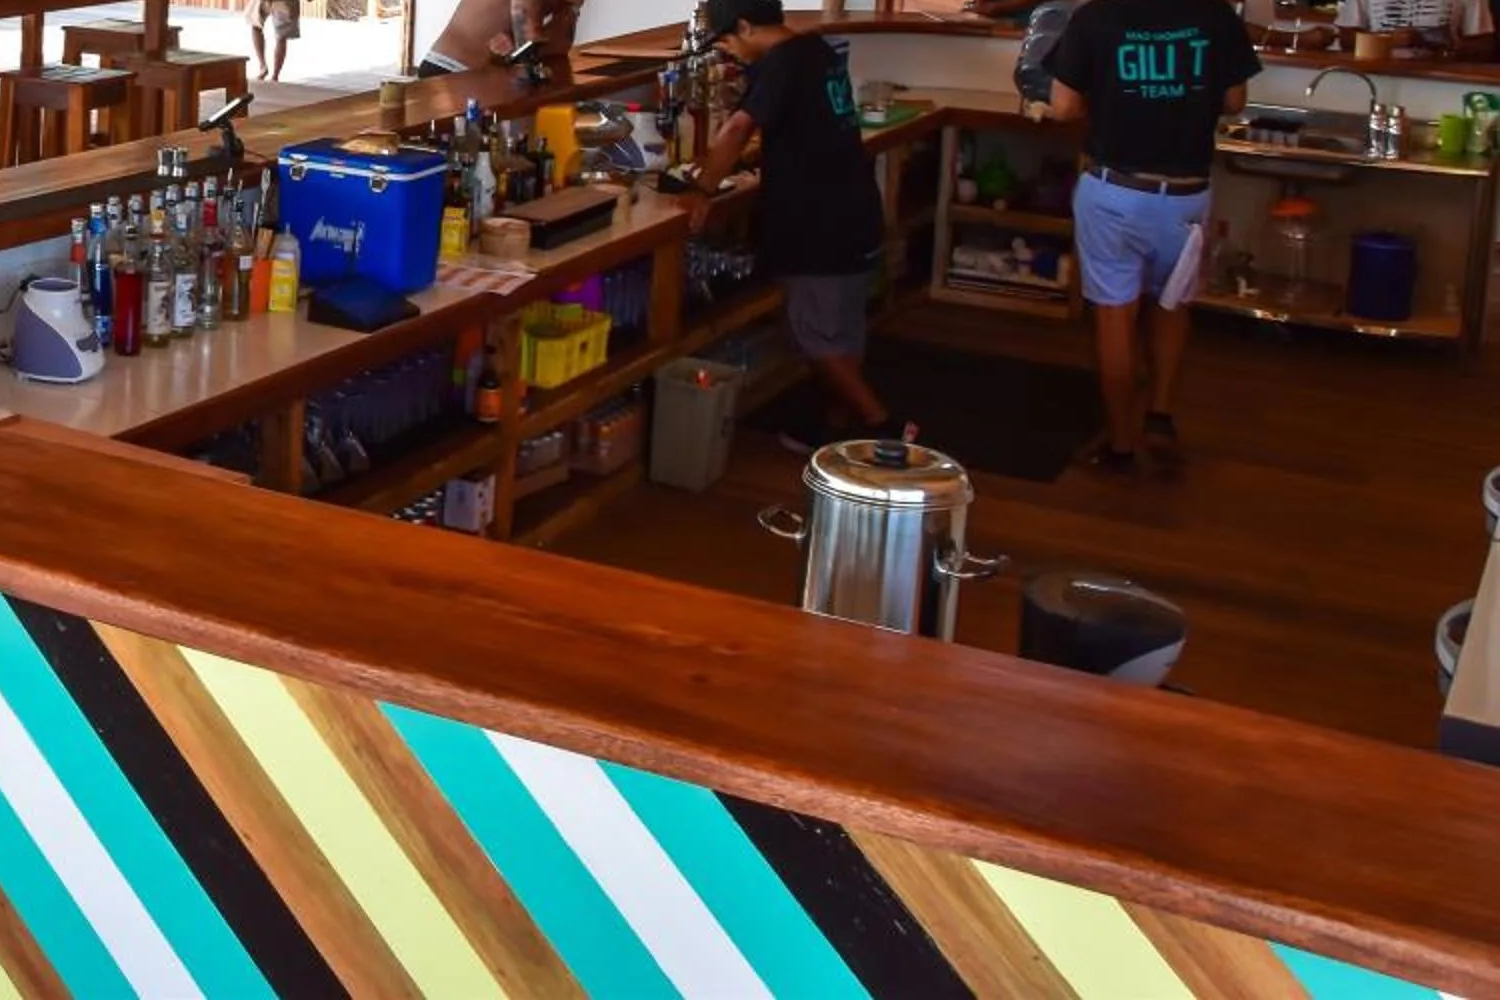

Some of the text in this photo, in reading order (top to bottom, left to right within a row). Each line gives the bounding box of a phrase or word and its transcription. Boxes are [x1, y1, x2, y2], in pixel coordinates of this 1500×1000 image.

[1118, 40, 1210, 81] GILI T
[1140, 84, 1185, 99] TEAM
